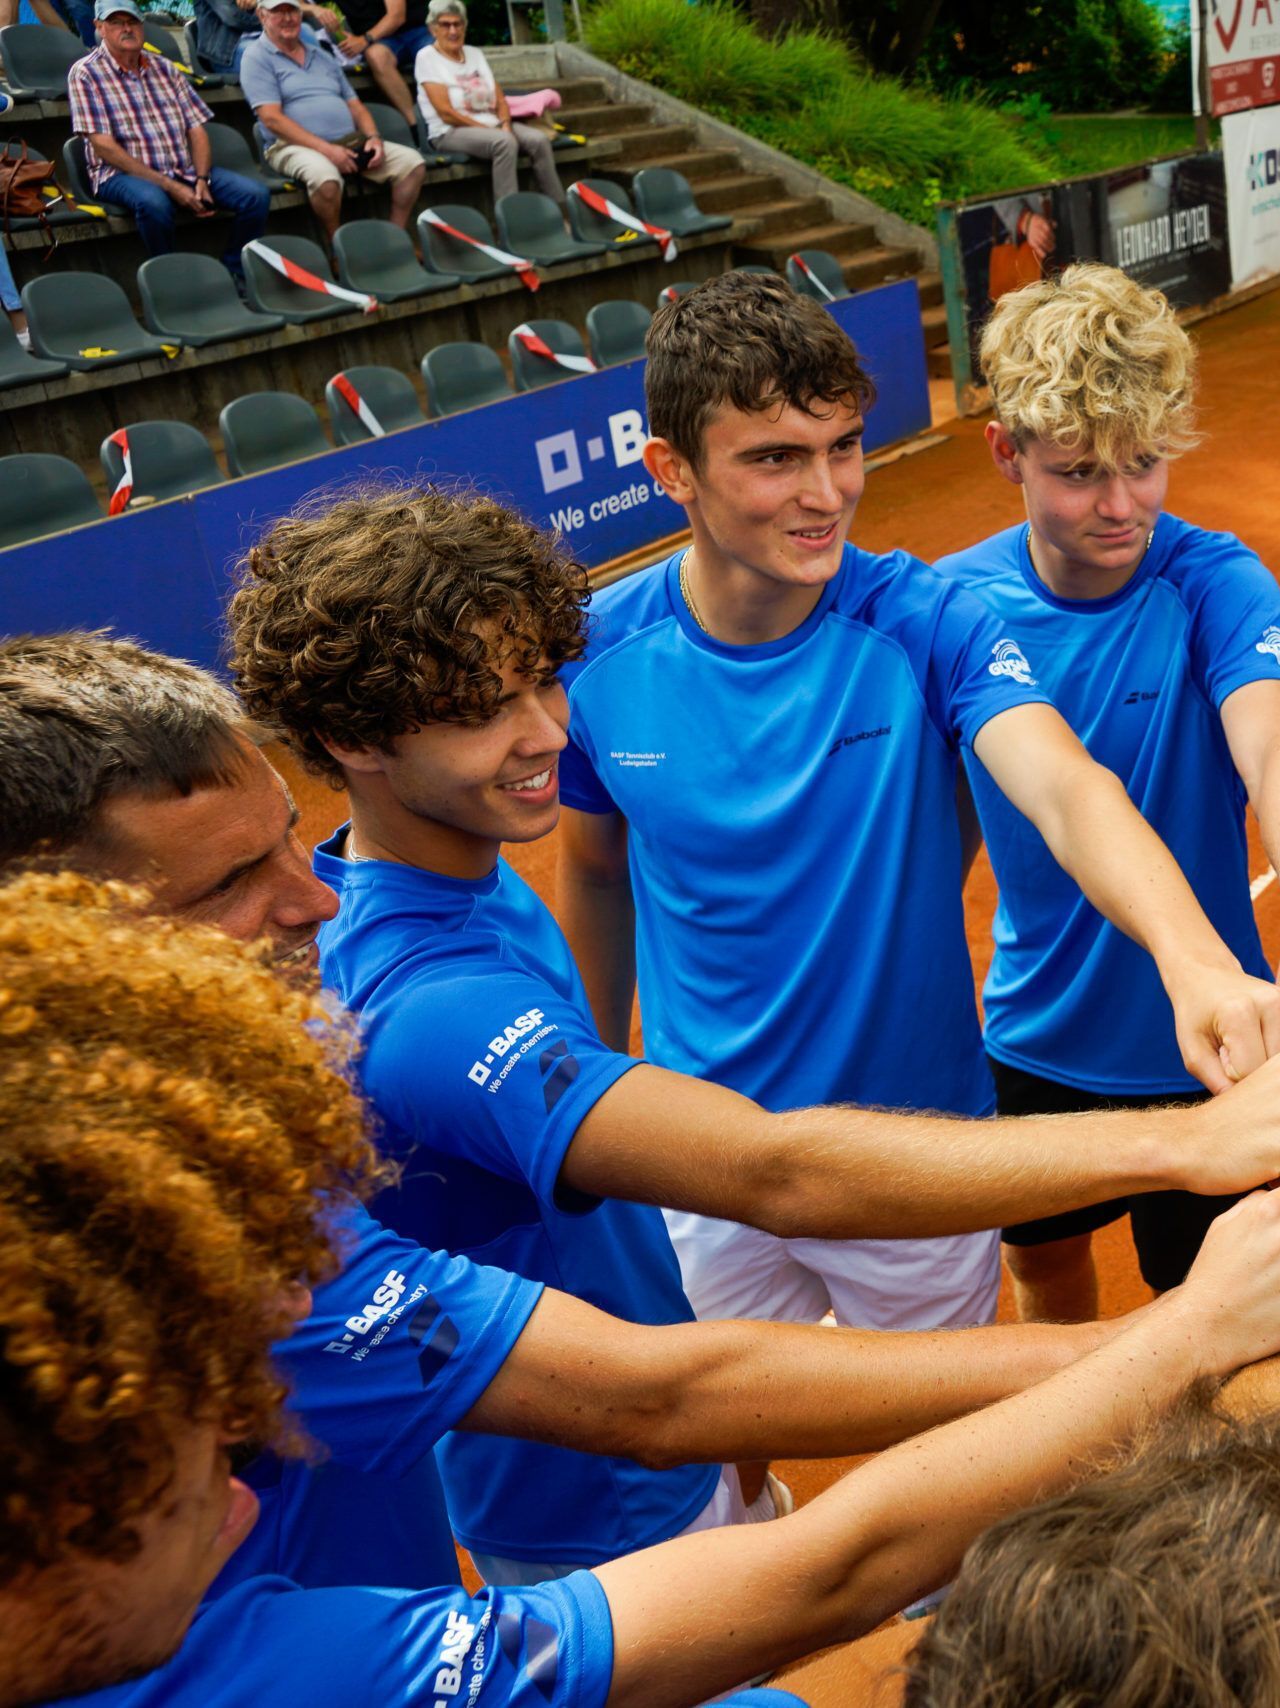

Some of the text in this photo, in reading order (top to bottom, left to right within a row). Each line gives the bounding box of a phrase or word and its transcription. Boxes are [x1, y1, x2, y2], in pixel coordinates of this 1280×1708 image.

[549, 505, 586, 533] We
[588, 483, 650, 523] create
[487, 1008, 545, 1058] BASF
[487, 1023, 559, 1094] We create chemistry
[345, 1269, 407, 1335] BASF
[351, 1346, 370, 1362] We
[432, 1609, 475, 1696] BASF
